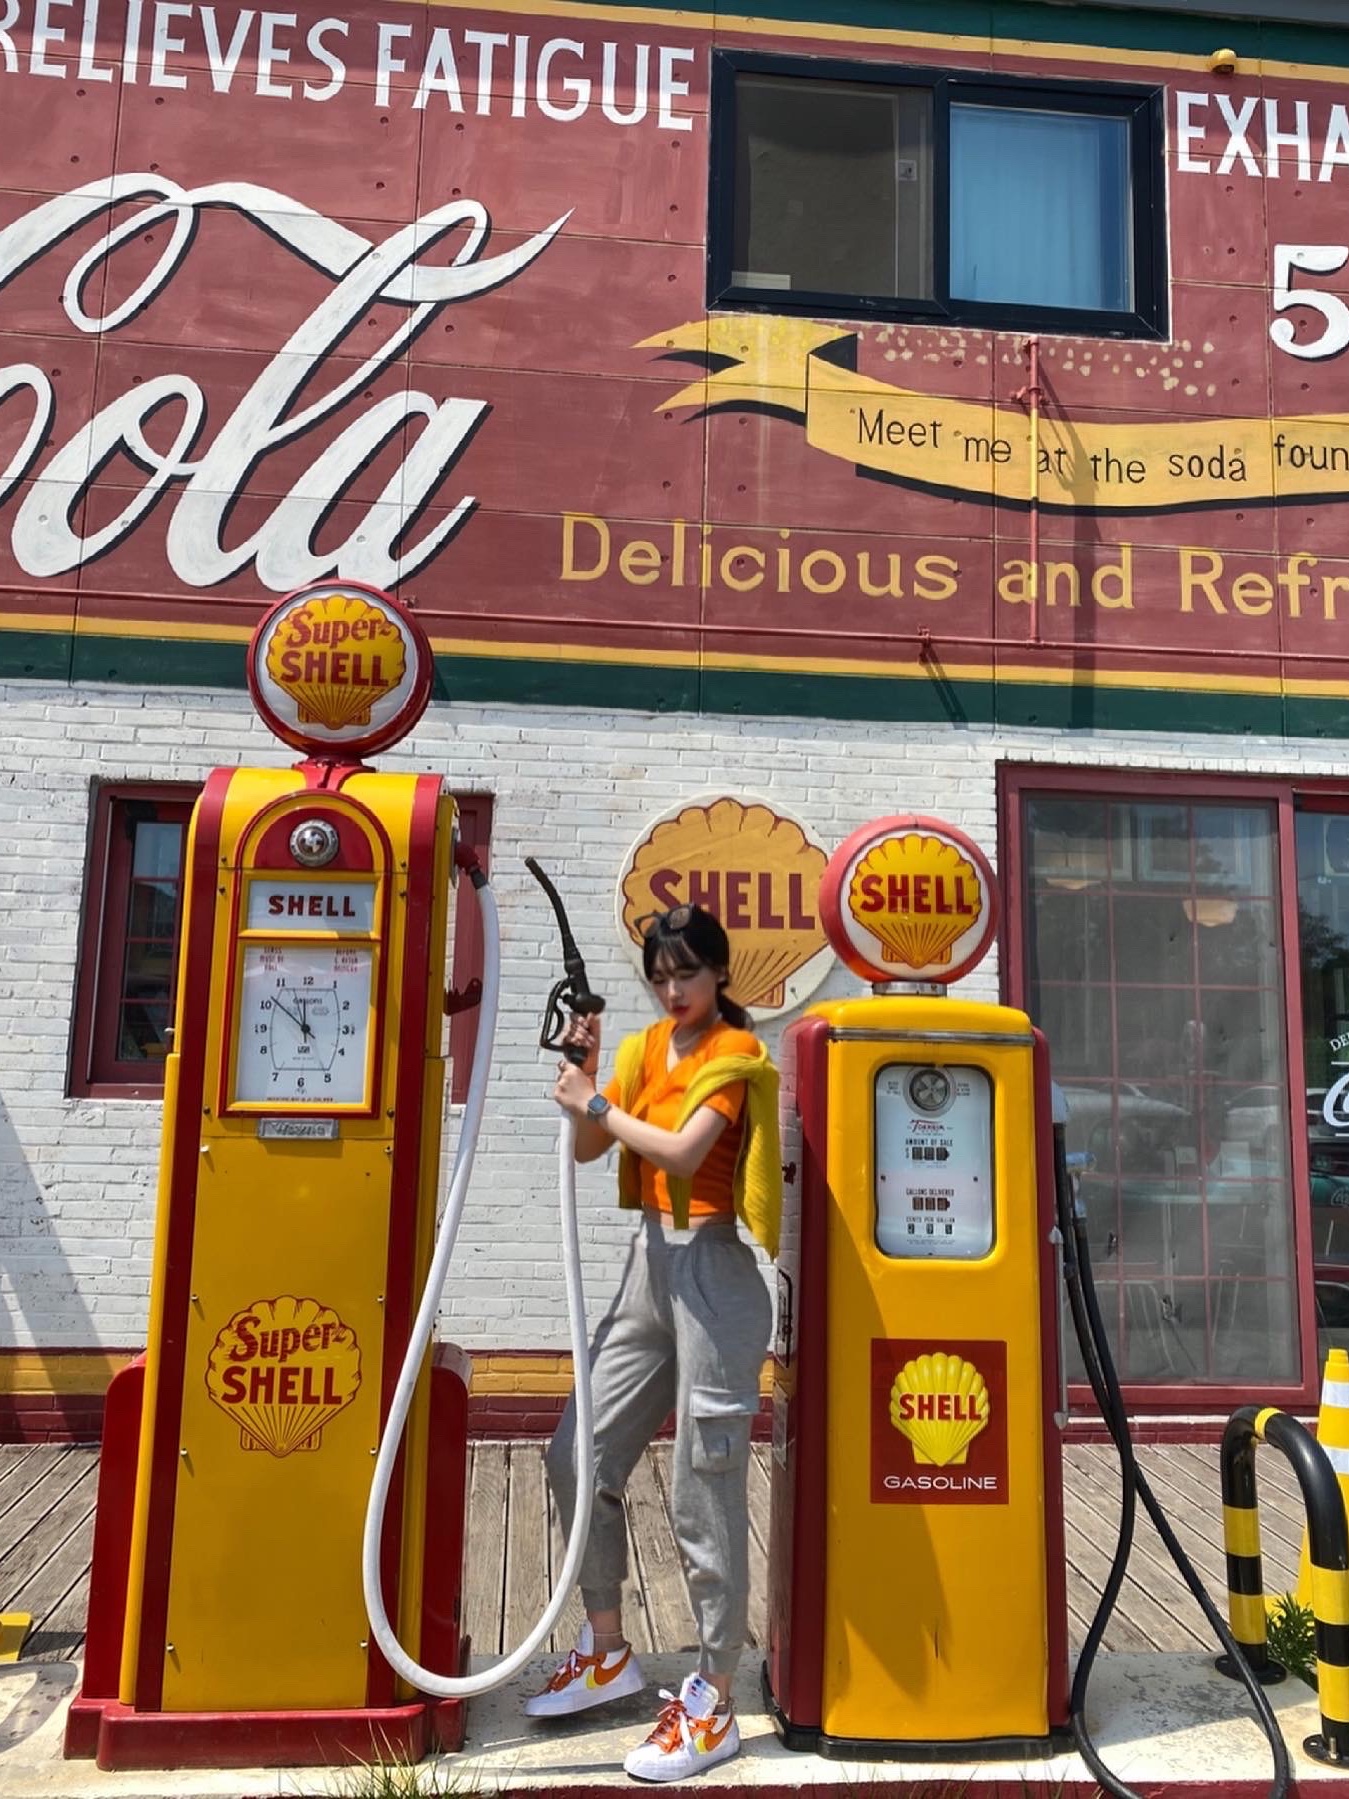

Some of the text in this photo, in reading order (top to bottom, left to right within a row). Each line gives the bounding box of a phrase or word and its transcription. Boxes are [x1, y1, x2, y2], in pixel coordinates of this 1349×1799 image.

[375, 21, 694, 131] FATIGUE
[1176, 90, 1349, 183] EXHA
[858, 407, 1349, 484] Meet me at the soda foun
[559, 510, 1349, 620] Delicious and Refr
[280, 651, 390, 688] SHELL
[649, 868, 817, 930] SHELL
[861, 873, 975, 916] SHELL
[268, 894, 357, 918] SHELL
[276, 978, 286, 988] 11
[302, 976, 315, 986] 12
[332, 980, 338, 989] 1
[260, 1000, 272, 1010] 10
[342, 1000, 350, 1010] 2
[259, 1045, 268, 1055] 8
[337, 1047, 345, 1056] 4
[271, 1073, 279, 1082] 7
[297, 1077, 305, 1087] 6
[324, 1073, 332, 1083] 5
[221, 1365, 343, 1406] SHELL
[899, 1393, 983, 1421] SHELL
[882, 1475, 998, 1490] GASOLINE
